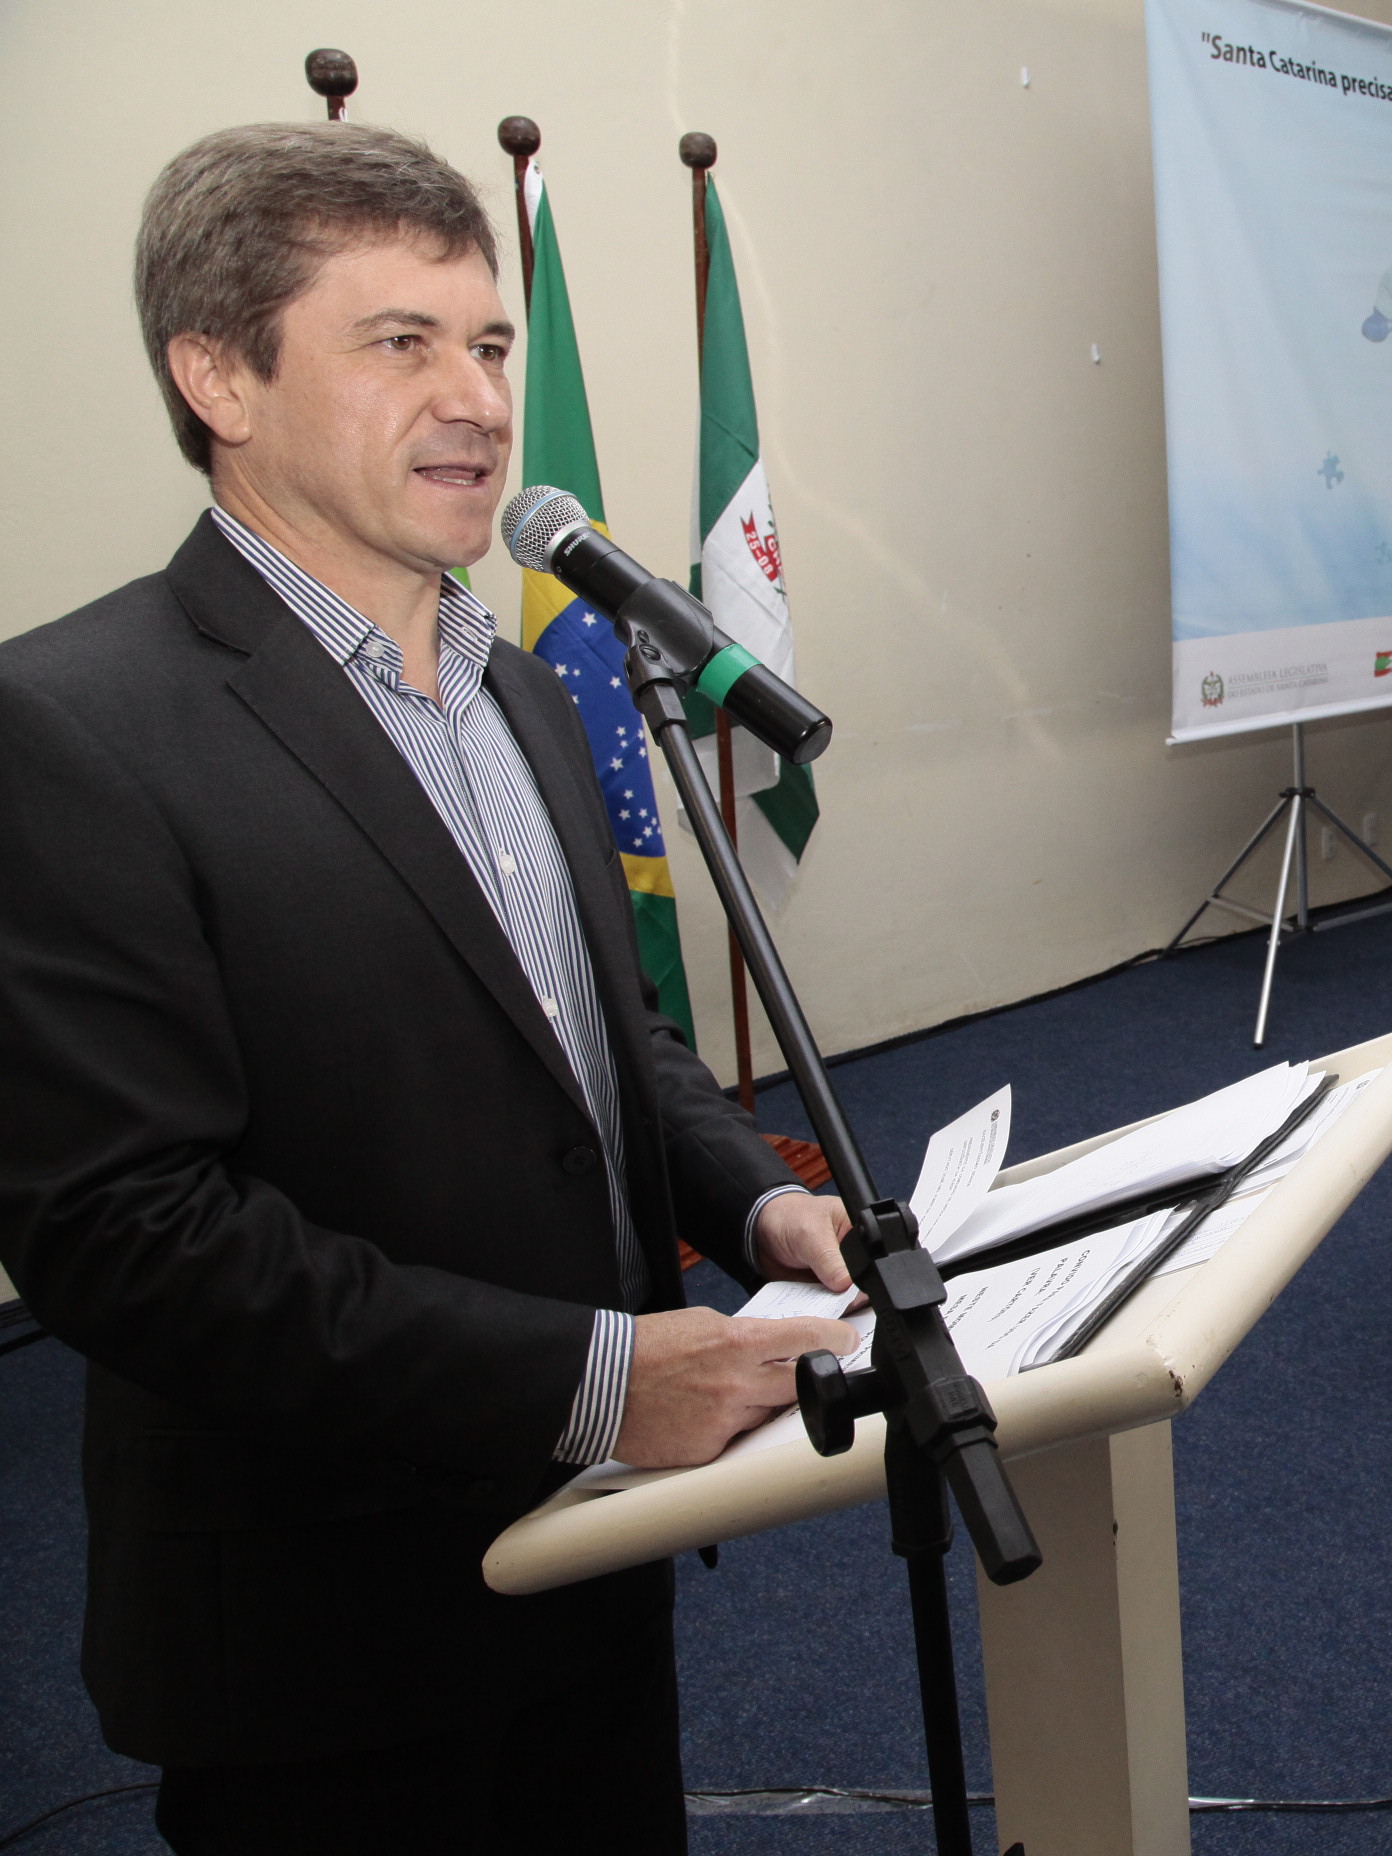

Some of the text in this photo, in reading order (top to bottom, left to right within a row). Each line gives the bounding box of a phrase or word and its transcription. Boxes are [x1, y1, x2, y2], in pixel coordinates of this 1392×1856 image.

[1201, 31, 1267, 69] "Santa
[1269, 50, 1337, 88] Catarina
[563, 531, 591, 557] SHURE
[745, 530, 774, 576] 25-08
